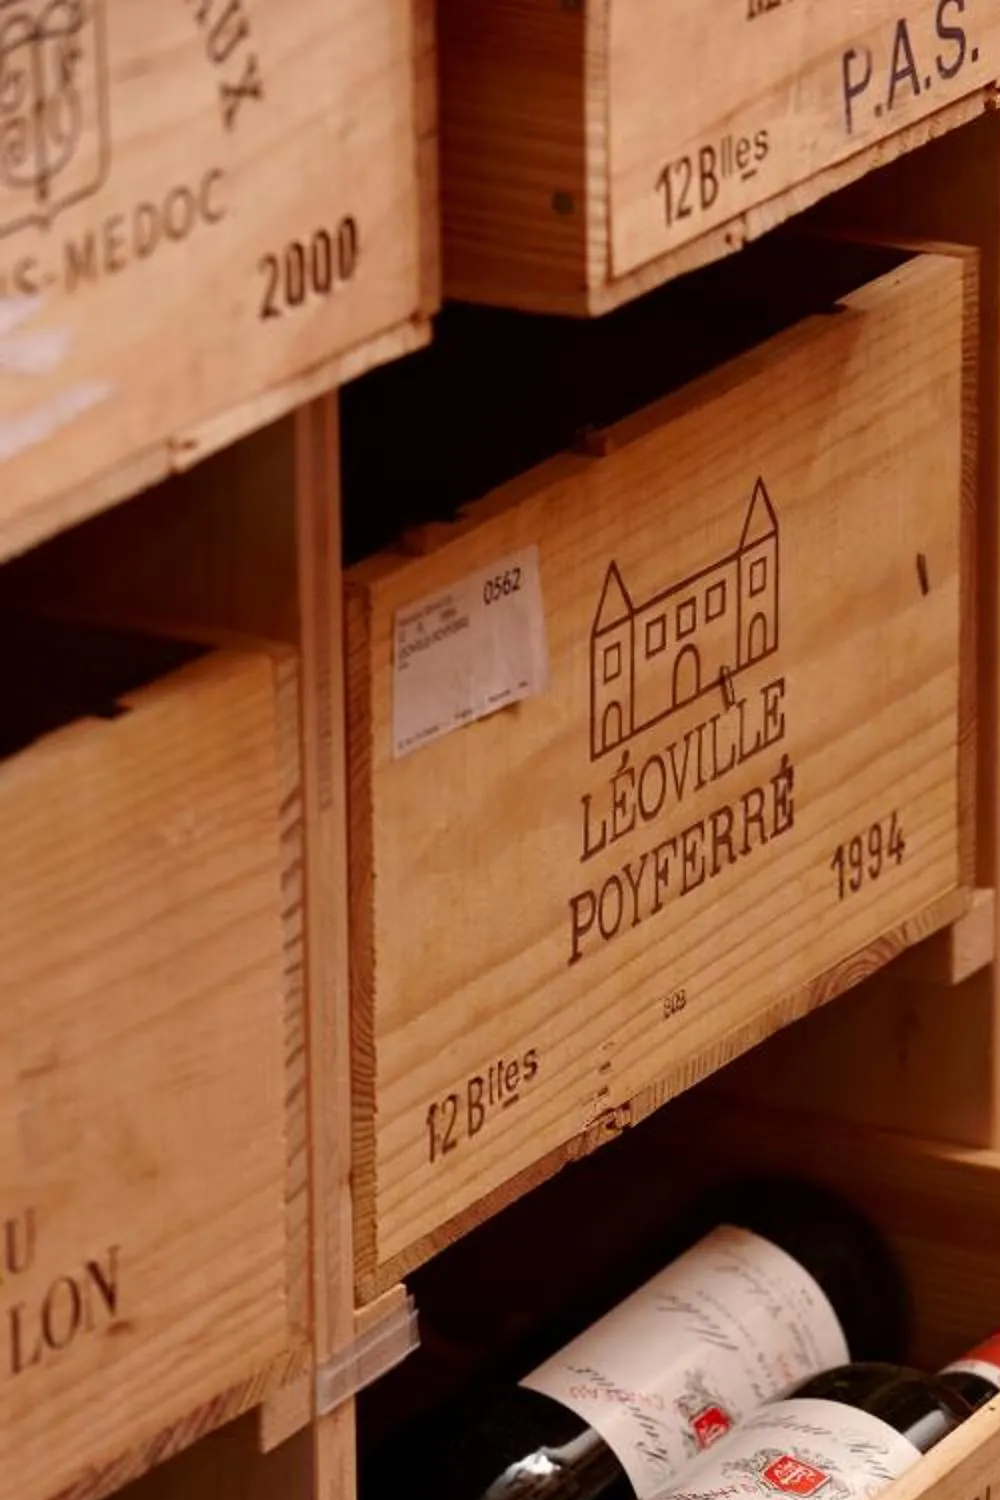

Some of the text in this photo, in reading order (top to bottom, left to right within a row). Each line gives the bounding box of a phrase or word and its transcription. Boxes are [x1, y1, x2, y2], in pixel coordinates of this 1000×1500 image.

[258, 215, 358, 320] 2000
[482, 566, 522, 606] 0562
[580, 676, 787, 863] LÉOVILLE
[567, 754, 796, 967] POYFERRÉ
[830, 810, 907, 901] 1994
